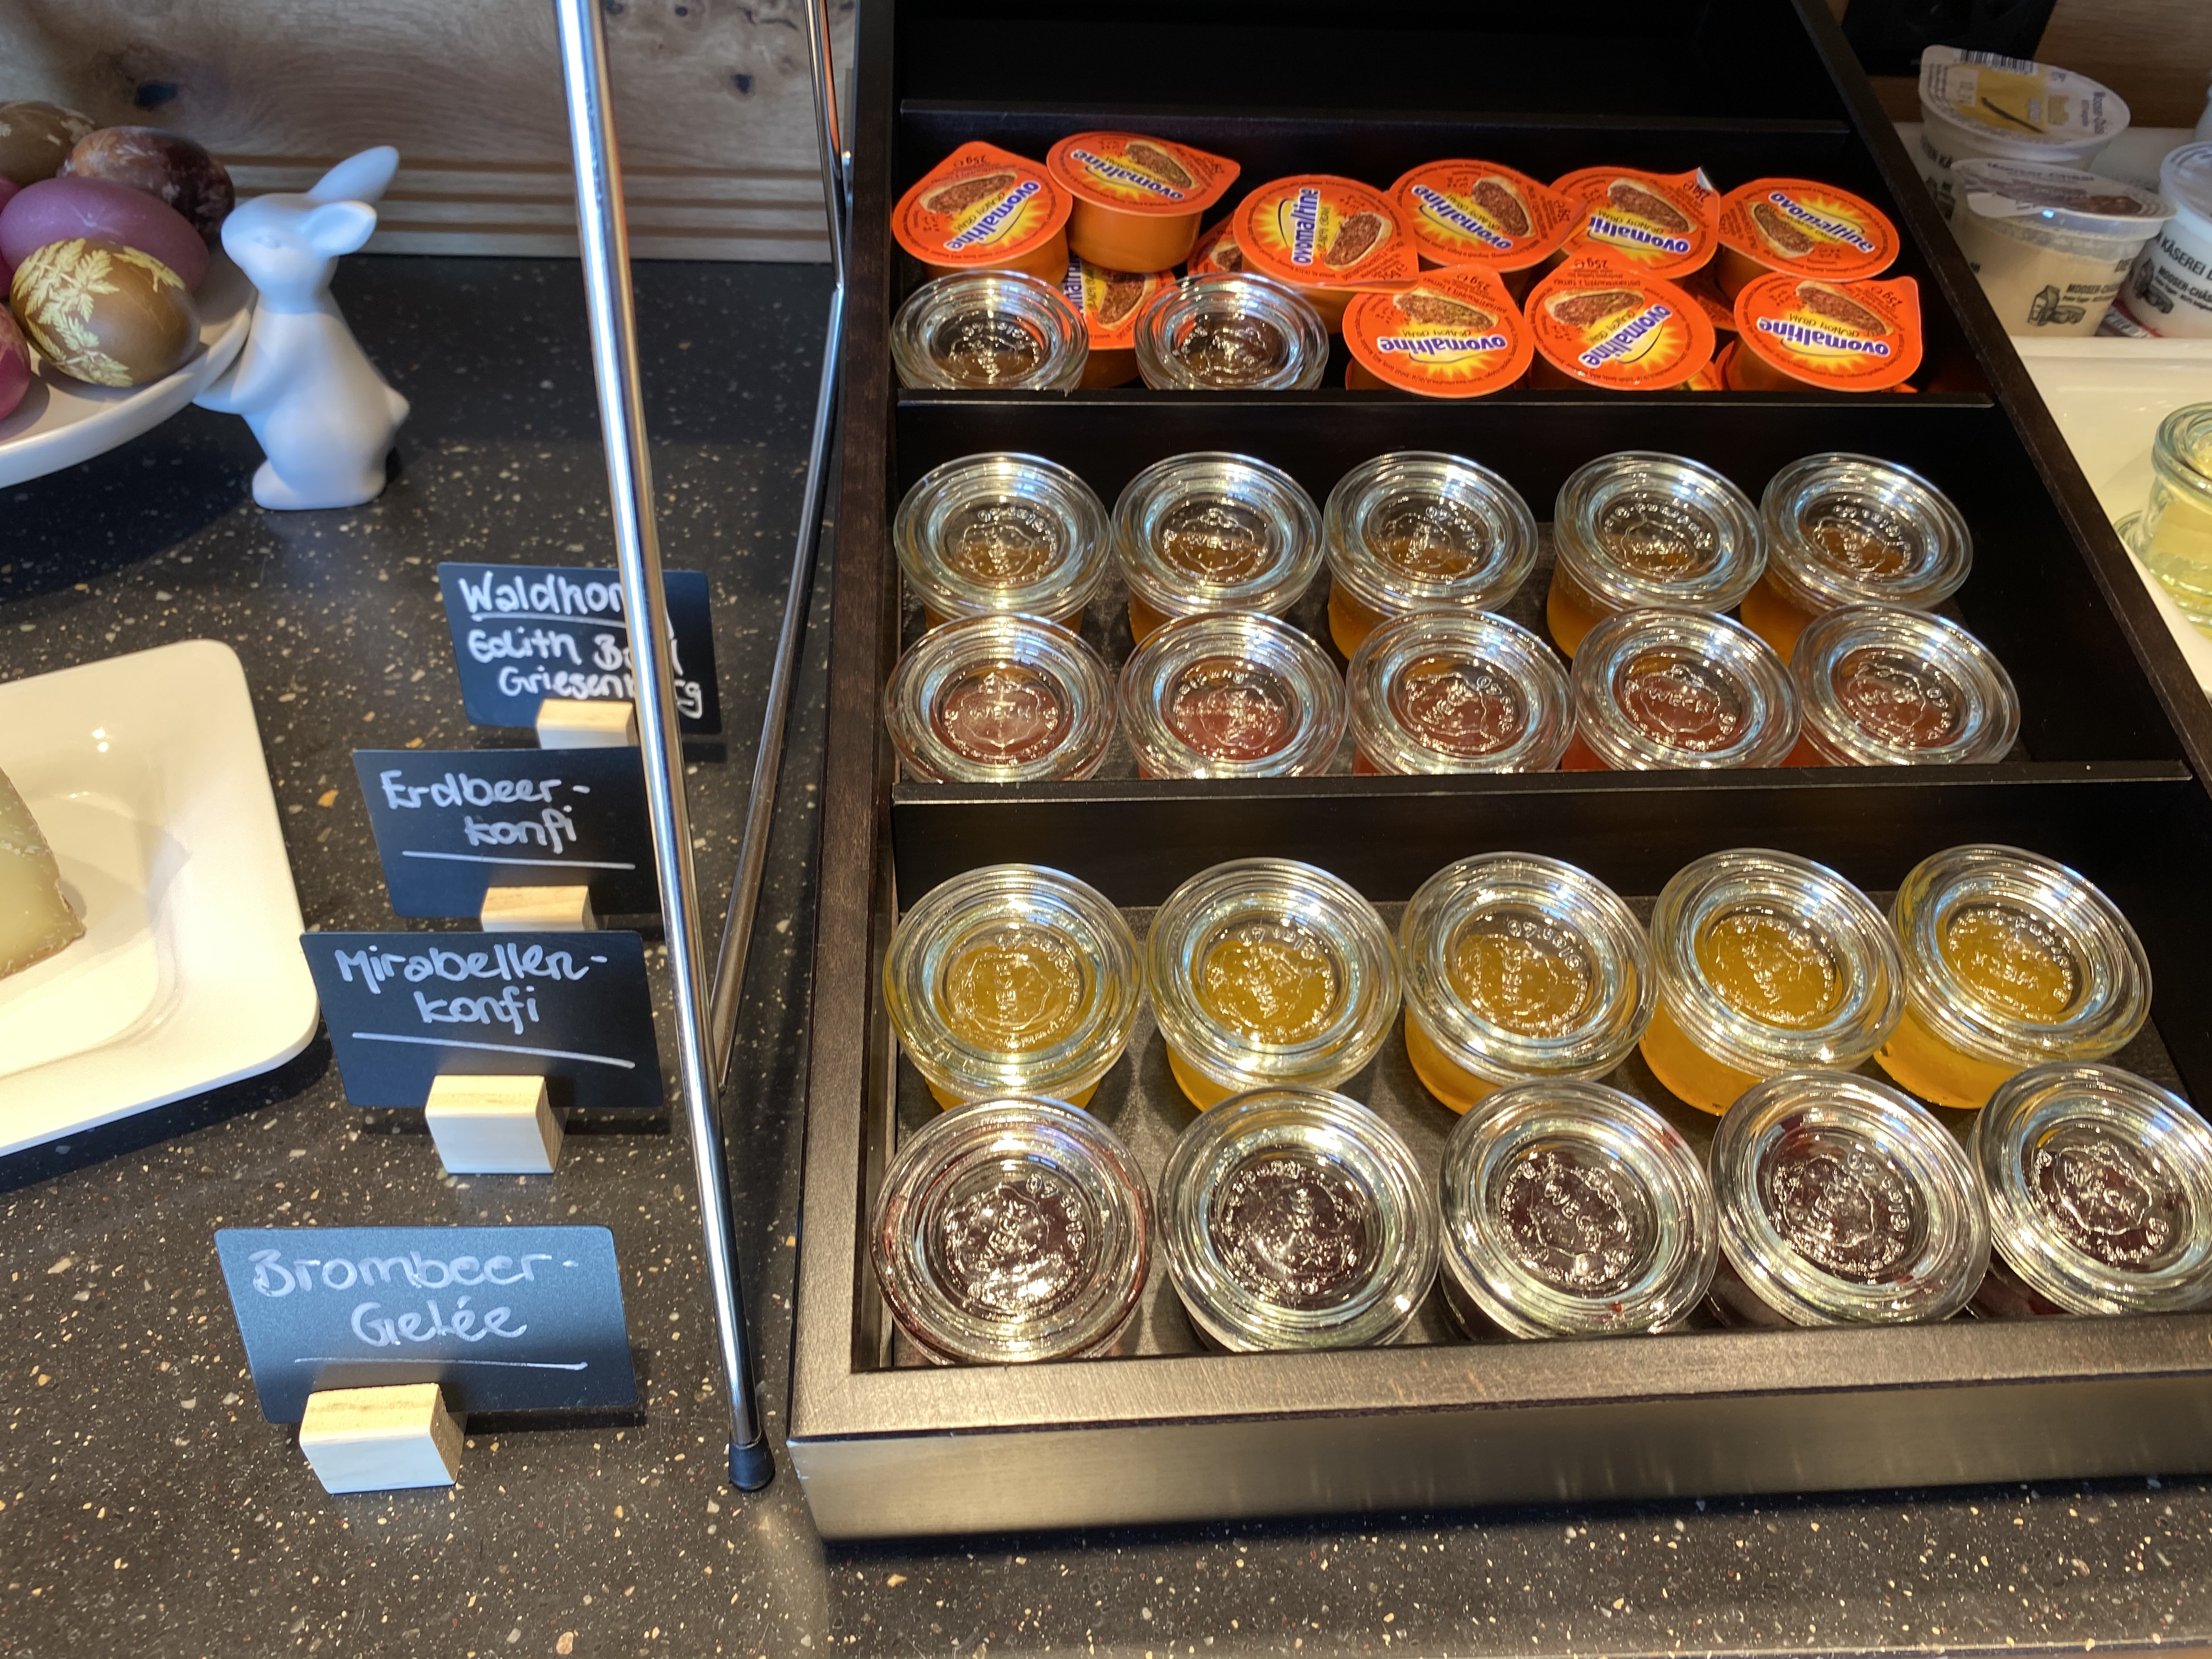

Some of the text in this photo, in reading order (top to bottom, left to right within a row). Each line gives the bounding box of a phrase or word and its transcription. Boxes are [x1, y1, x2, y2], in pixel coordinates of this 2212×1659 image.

[1070, 150, 1184, 200] ovomaltine
[946, 181, 1040, 250] ovomaltine
[1290, 188, 1319, 264] ovomaltine
[1412, 186, 1513, 249] ovomaltine
[1589, 216, 1689, 253] ovomalti
[1769, 192, 1875, 252] ovomaltine
[1380, 336, 1506, 356] ovomaltine
[1581, 304, 1672, 366] ovomaltine
[1758, 317, 1890, 356] ovomaltine
[1649, 685, 1709, 714] WECK
[379, 769, 591, 810] Erdbeer-
[334, 943, 608, 995] Mirabellen-
[248, 1249, 579, 1299] Brombeer-
[351, 1294, 528, 1347] Gelée
